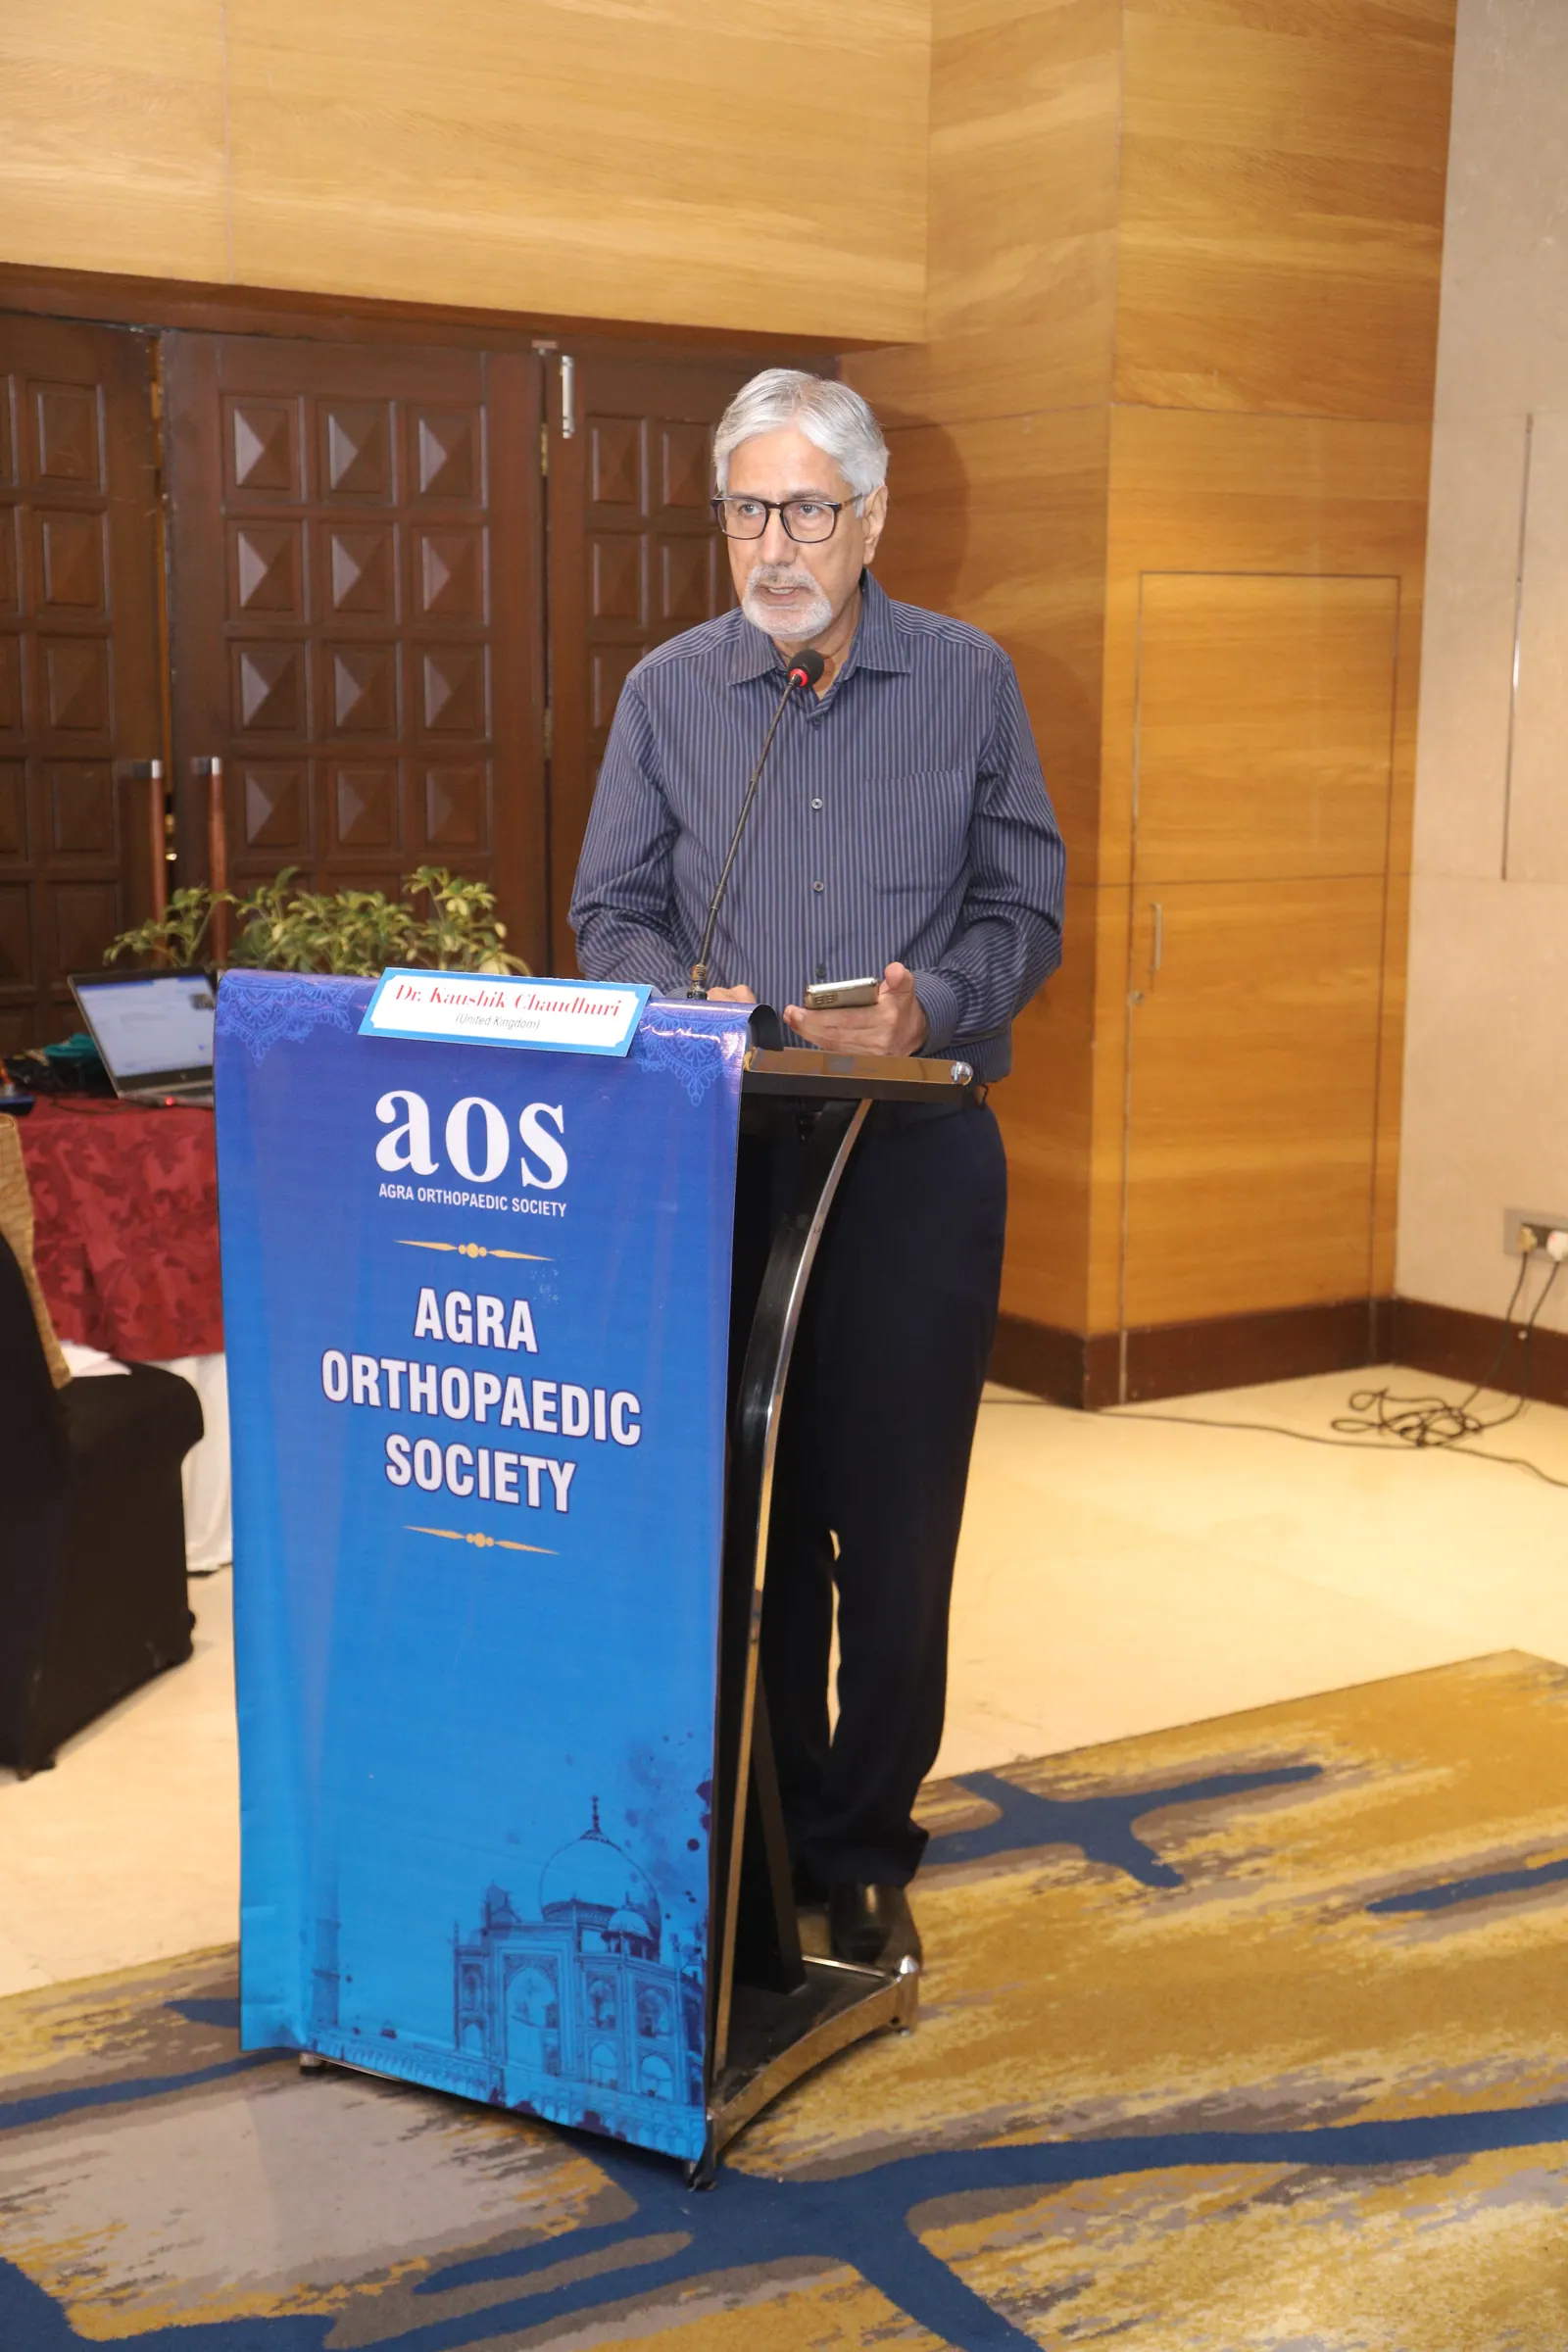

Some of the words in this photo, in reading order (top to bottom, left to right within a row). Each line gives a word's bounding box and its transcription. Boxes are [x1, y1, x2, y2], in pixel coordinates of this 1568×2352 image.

[395, 984, 421, 1003] Dr.
[429, 987, 507, 1009] Kaushik
[514, 994, 622, 1017] Chaudhuri
[455, 1013, 492, 1027] (United
[493, 1015, 541, 1030] Kingdom)
[375, 1090, 568, 1190] aos
[378, 1183, 415, 1201] AGRA
[416, 1188, 509, 1211] ORTHOPAEDIC
[512, 1199, 567, 1218] SOCIETY
[414, 1287, 538, 1354] AGRA
[321, 1348, 643, 1446] ORTHOPAEDIC
[384, 1434, 578, 1513] SOCIETY
